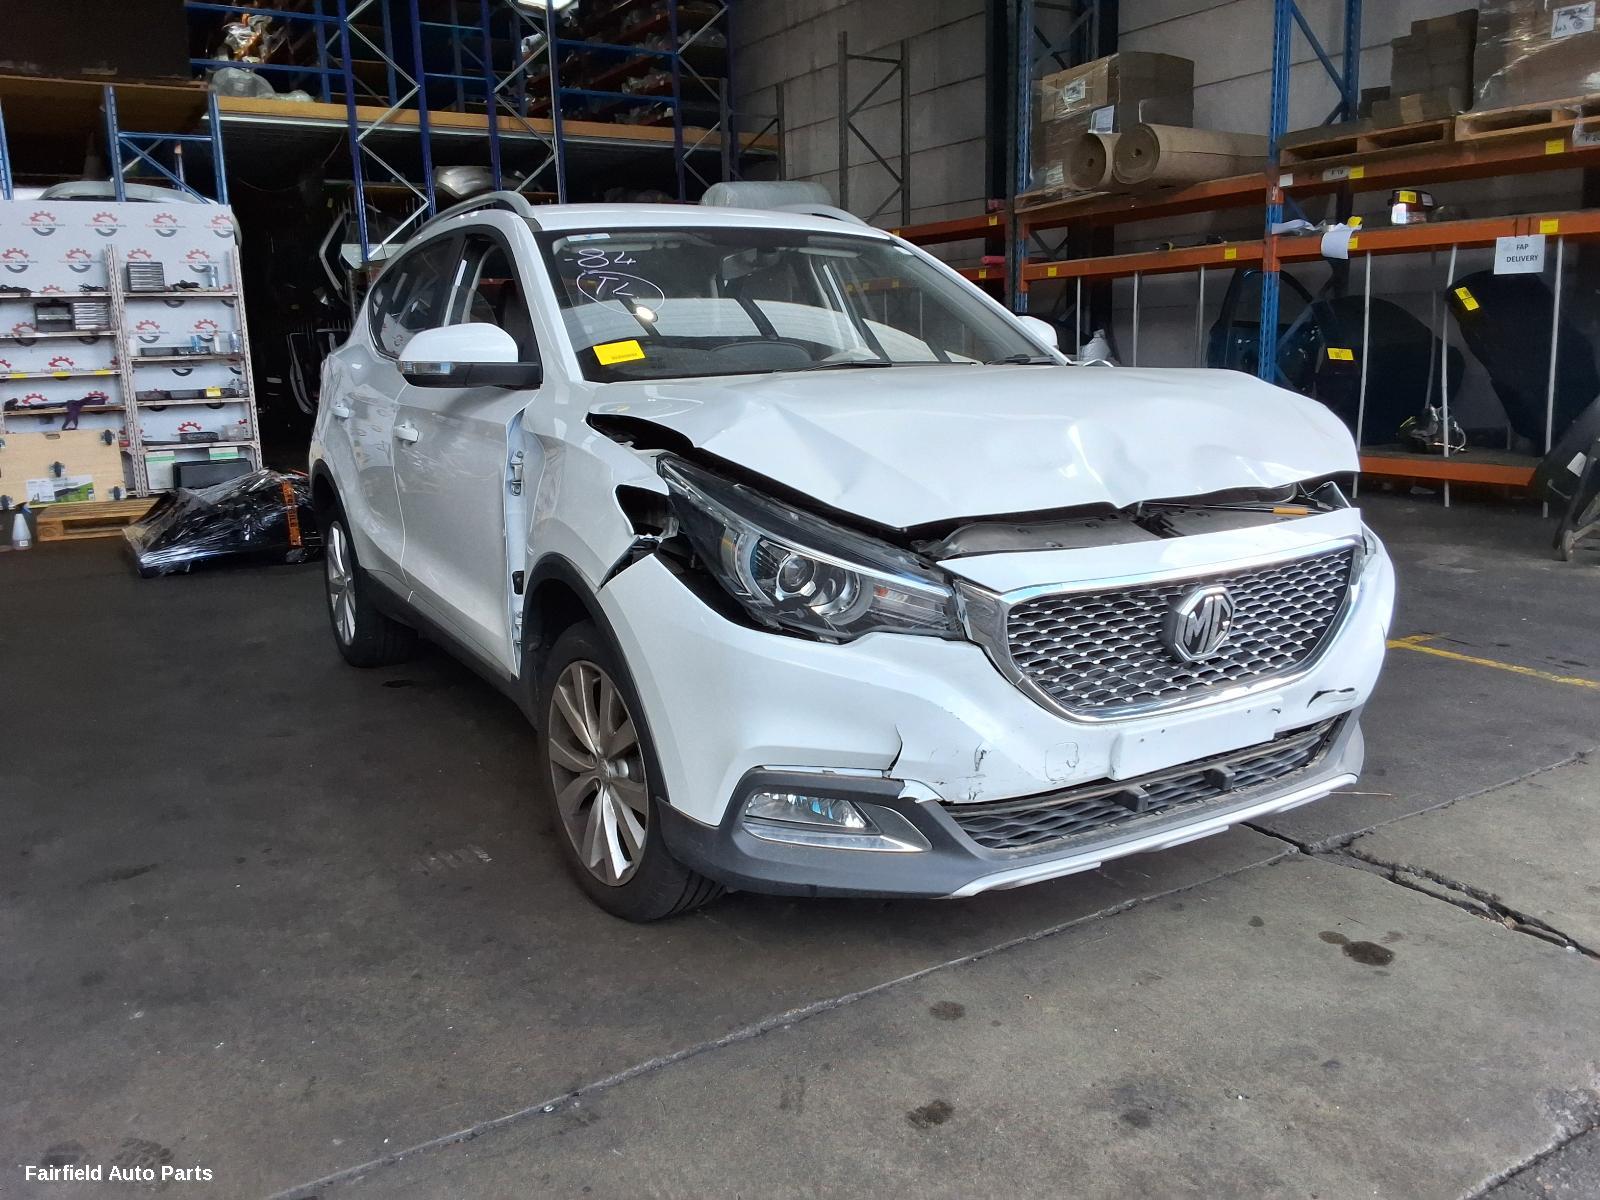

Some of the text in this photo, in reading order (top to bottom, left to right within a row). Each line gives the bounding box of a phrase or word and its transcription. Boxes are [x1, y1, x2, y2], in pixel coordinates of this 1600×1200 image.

[1516, 243, 1529, 251] FAP
[1506, 254, 1539, 263] DELIVERY
[1184, 595, 1231, 653] MG
